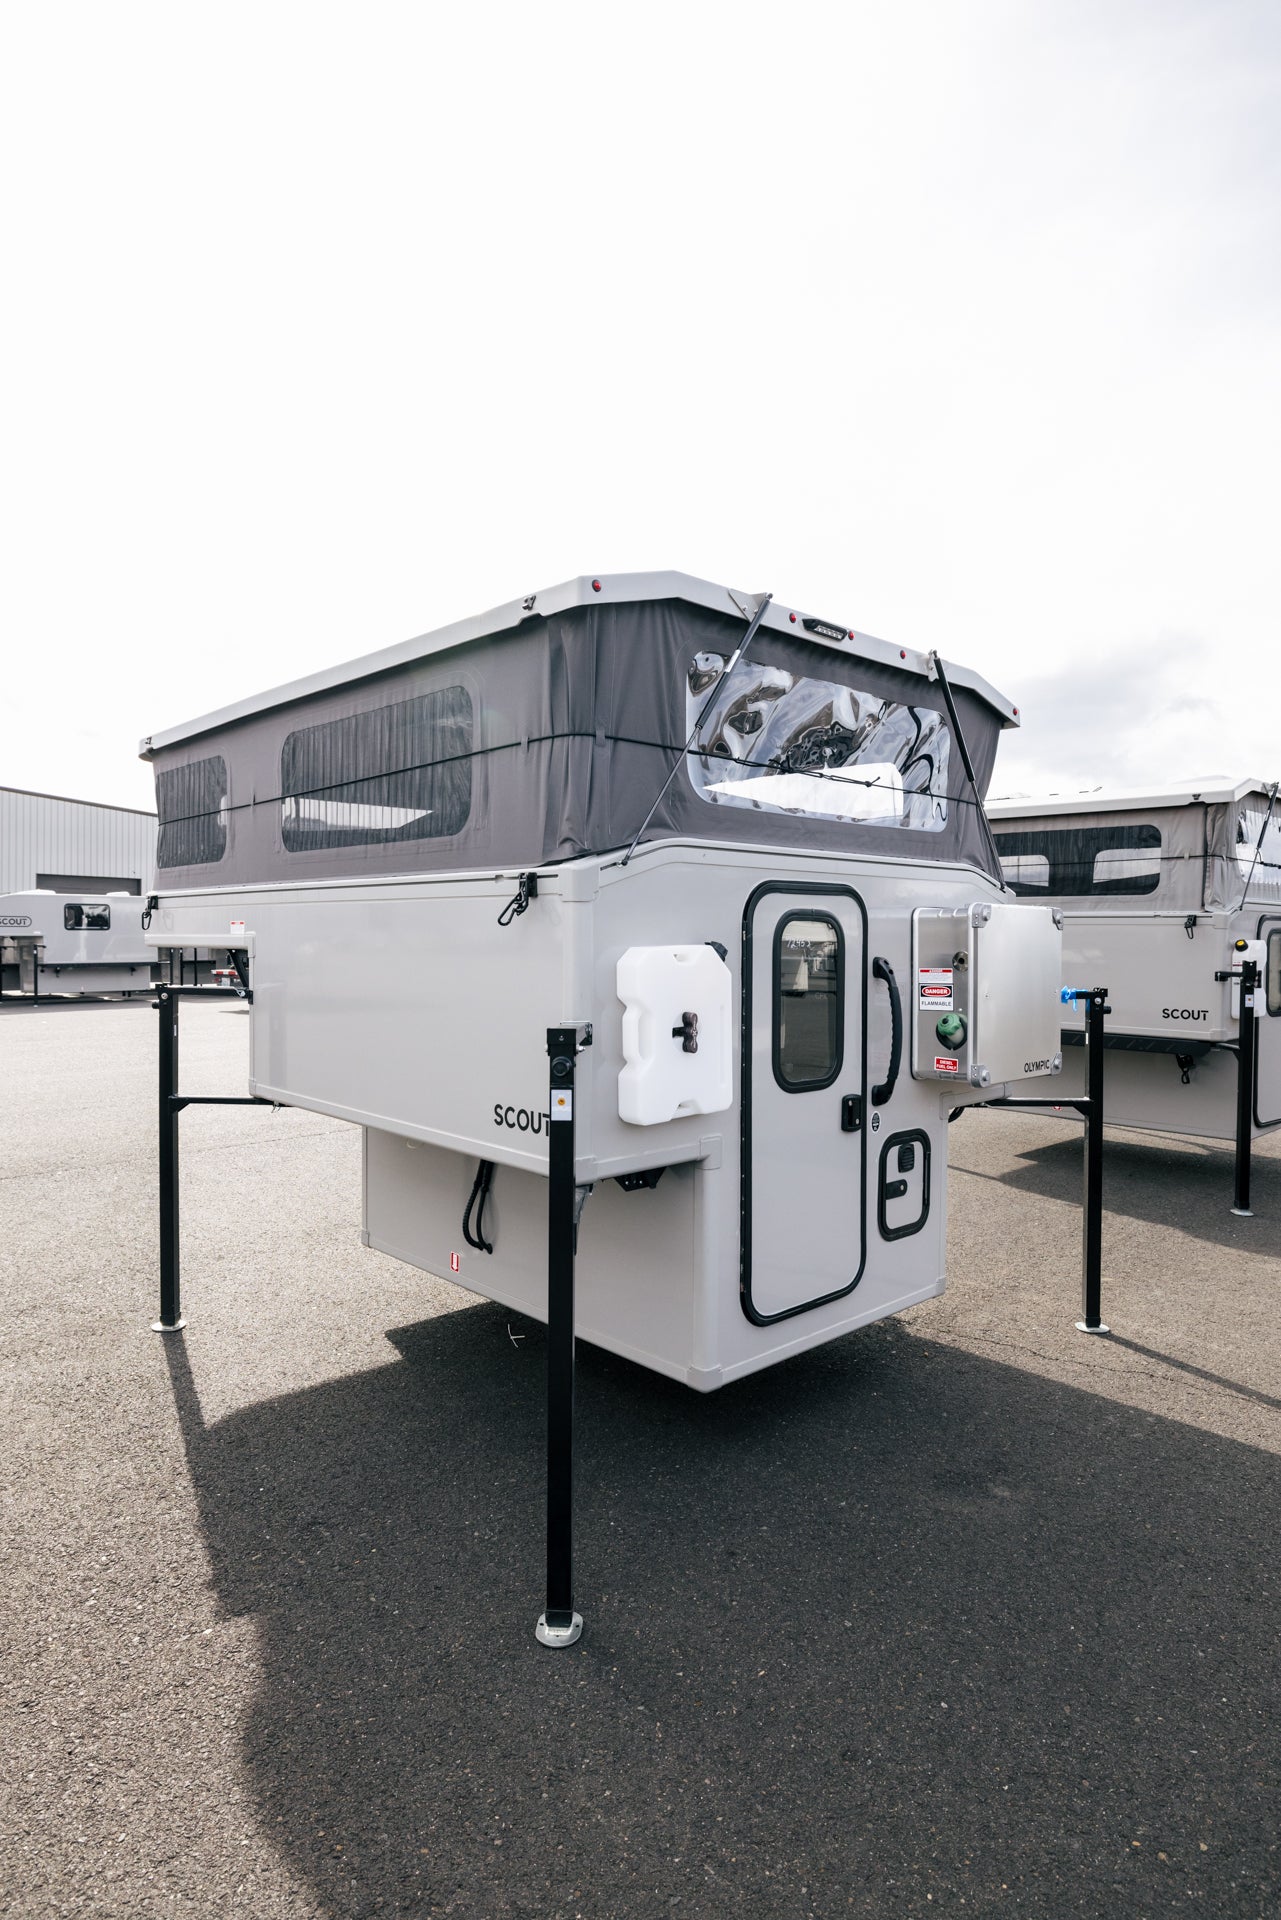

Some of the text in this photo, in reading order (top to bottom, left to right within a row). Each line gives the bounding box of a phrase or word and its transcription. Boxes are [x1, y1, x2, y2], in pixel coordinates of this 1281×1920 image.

[0, 918, 27, 926] COUT
[1162, 1008, 1209, 1021] SCOUT
[1024, 1059, 1050, 1073] OLYMPIC
[493, 1104, 550, 1137] SCOUT
